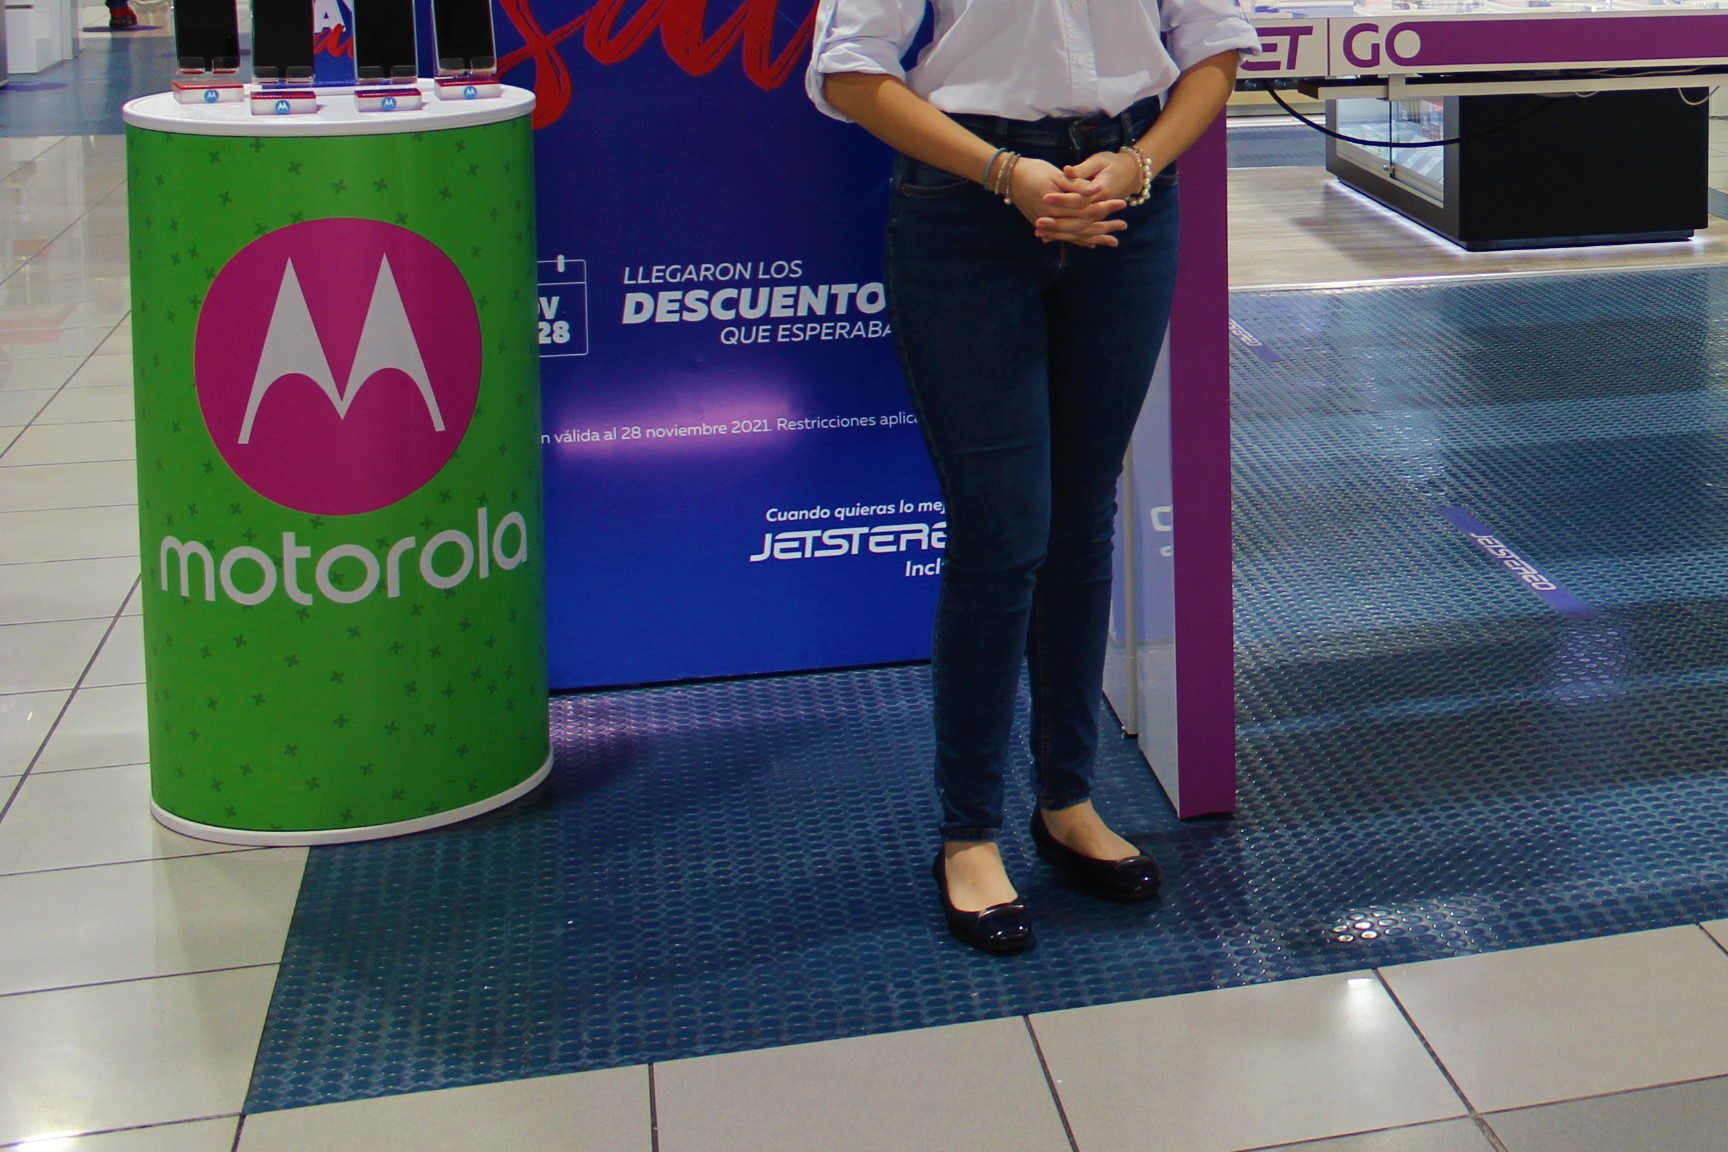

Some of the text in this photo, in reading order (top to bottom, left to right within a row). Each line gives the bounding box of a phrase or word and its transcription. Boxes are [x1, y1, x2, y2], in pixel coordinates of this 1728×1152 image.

[1240, 22, 1421, 71] ET GO
[623, 260, 803, 285] LLEGARON LOS
[622, 282, 887, 324] DESCUENTO
[720, 320, 892, 345] QUE ESPERABA
[554, 427, 600, 445] válida
[604, 427, 617, 440] al
[621, 426, 642, 440] 28
[646, 421, 728, 439] noviembre
[731, 419, 773, 434] 2021.
[777, 413, 876, 432] Restricciones
[766, 500, 914, 522] Cuando quieras lo
[160, 506, 528, 606] motorola
[750, 521, 947, 562] JETSTERE
[1470, 532, 1557, 592] JETSTEREO
